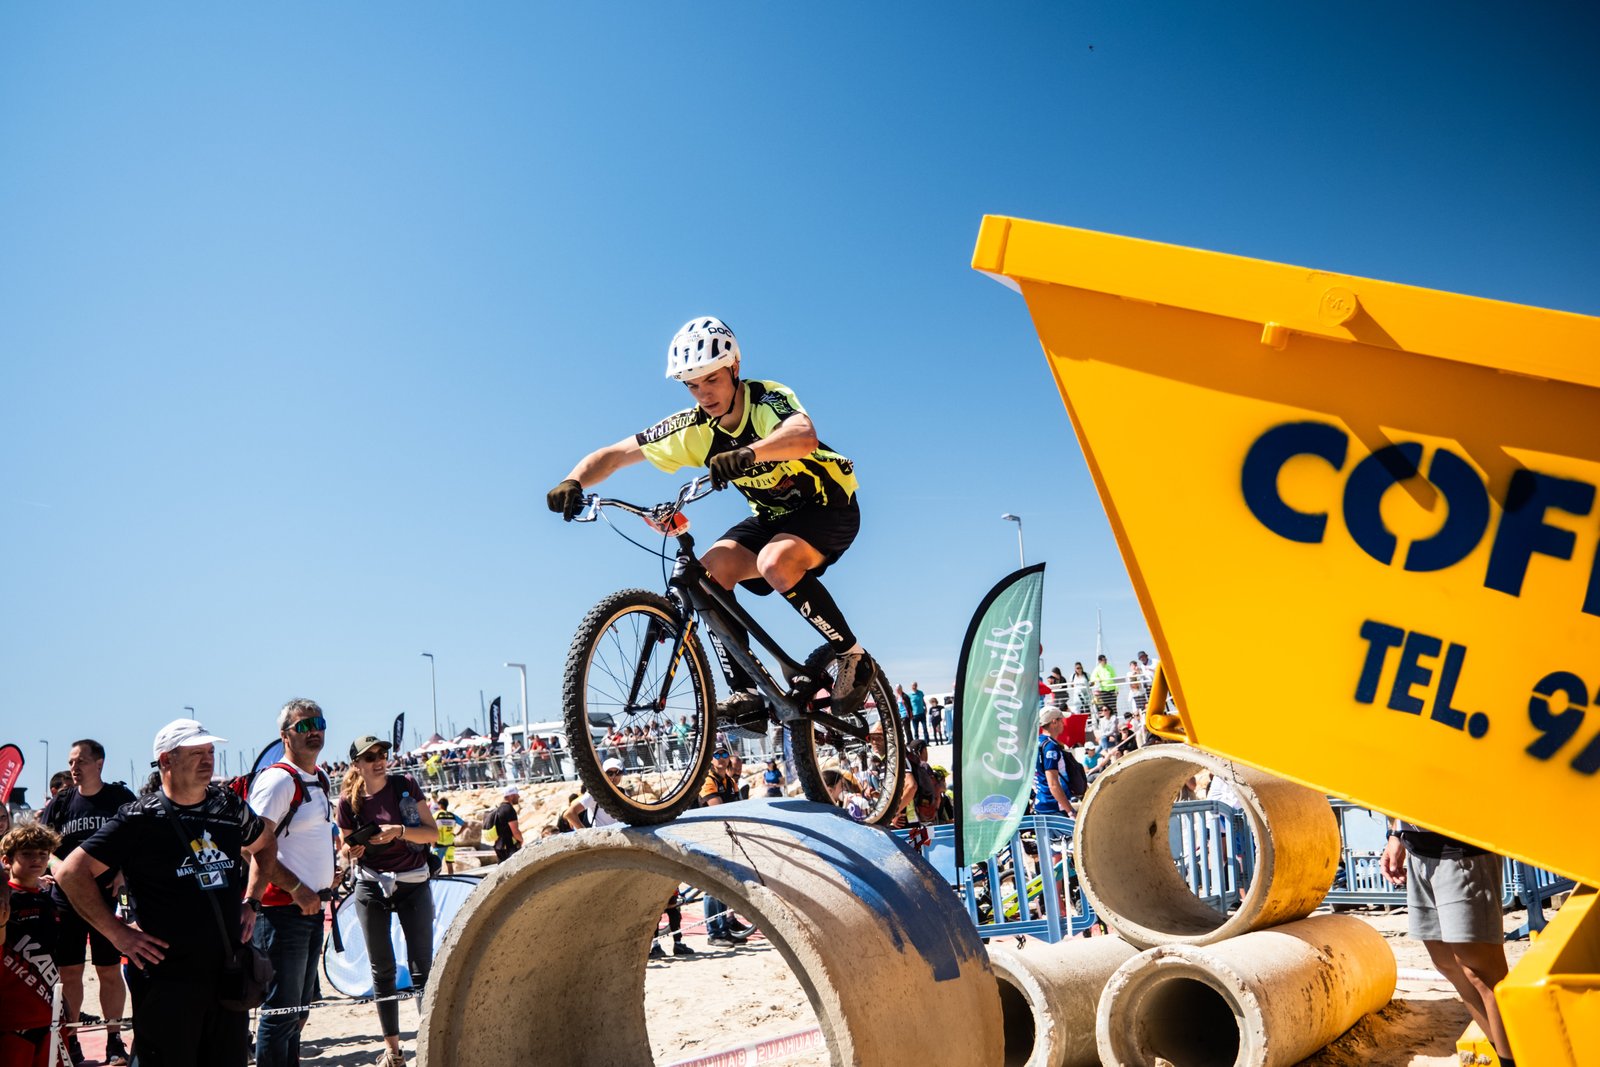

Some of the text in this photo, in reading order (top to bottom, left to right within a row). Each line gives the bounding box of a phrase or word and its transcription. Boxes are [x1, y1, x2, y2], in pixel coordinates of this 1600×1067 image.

[982, 616, 1034, 781] Cambrils
[1354, 618, 1490, 739] TEL.
[0, 760, 15, 800] HAUS
[61, 816, 110, 836] UNDERSTA
[36, 984, 53, 1007] SK
